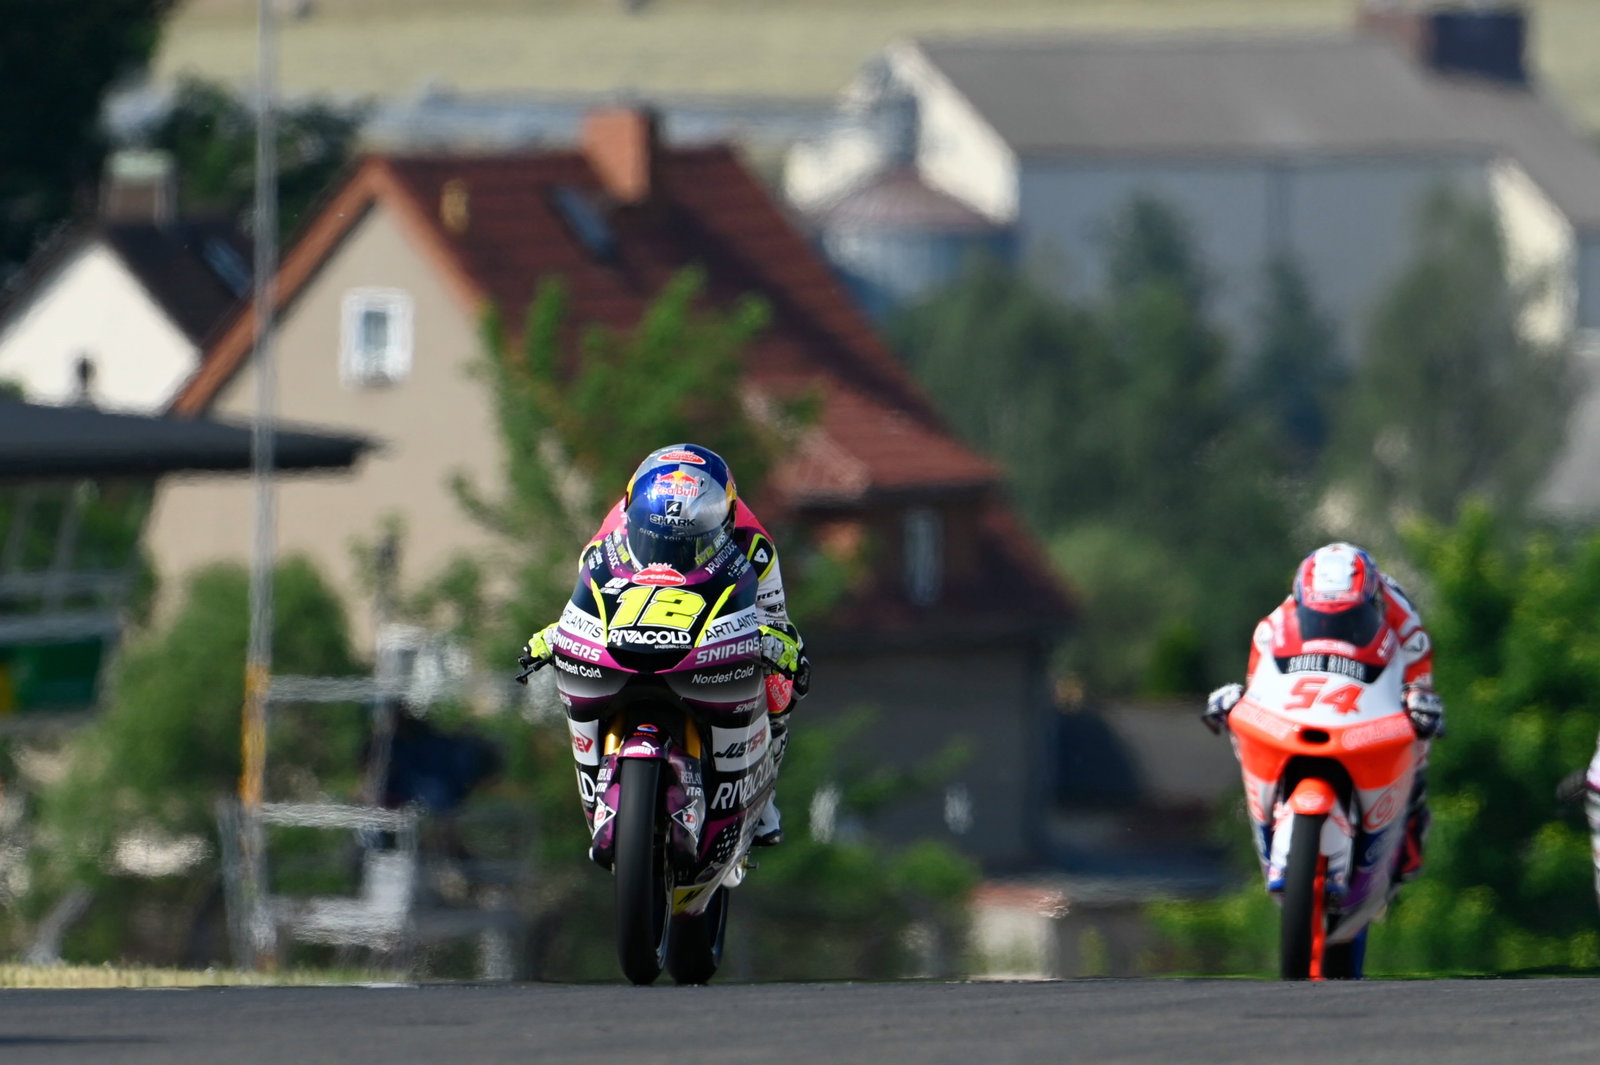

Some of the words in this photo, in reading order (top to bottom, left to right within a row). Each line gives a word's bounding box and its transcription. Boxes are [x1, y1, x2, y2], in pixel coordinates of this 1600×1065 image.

[676, 485, 699, 497] Bull
[650, 513, 696, 527] SHARK
[608, 585, 706, 632] 12
[607, 630, 692, 646] RIVACOLD
[695, 637, 760, 665] SNIPERS
[555, 655, 579, 675] Nordest
[579, 665, 602, 678] Cold
[1288, 653, 1324, 673] SKULL
[692, 673, 732, 684] Nordest
[734, 664, 755, 680] Cold
[1284, 677, 1364, 715] 54
